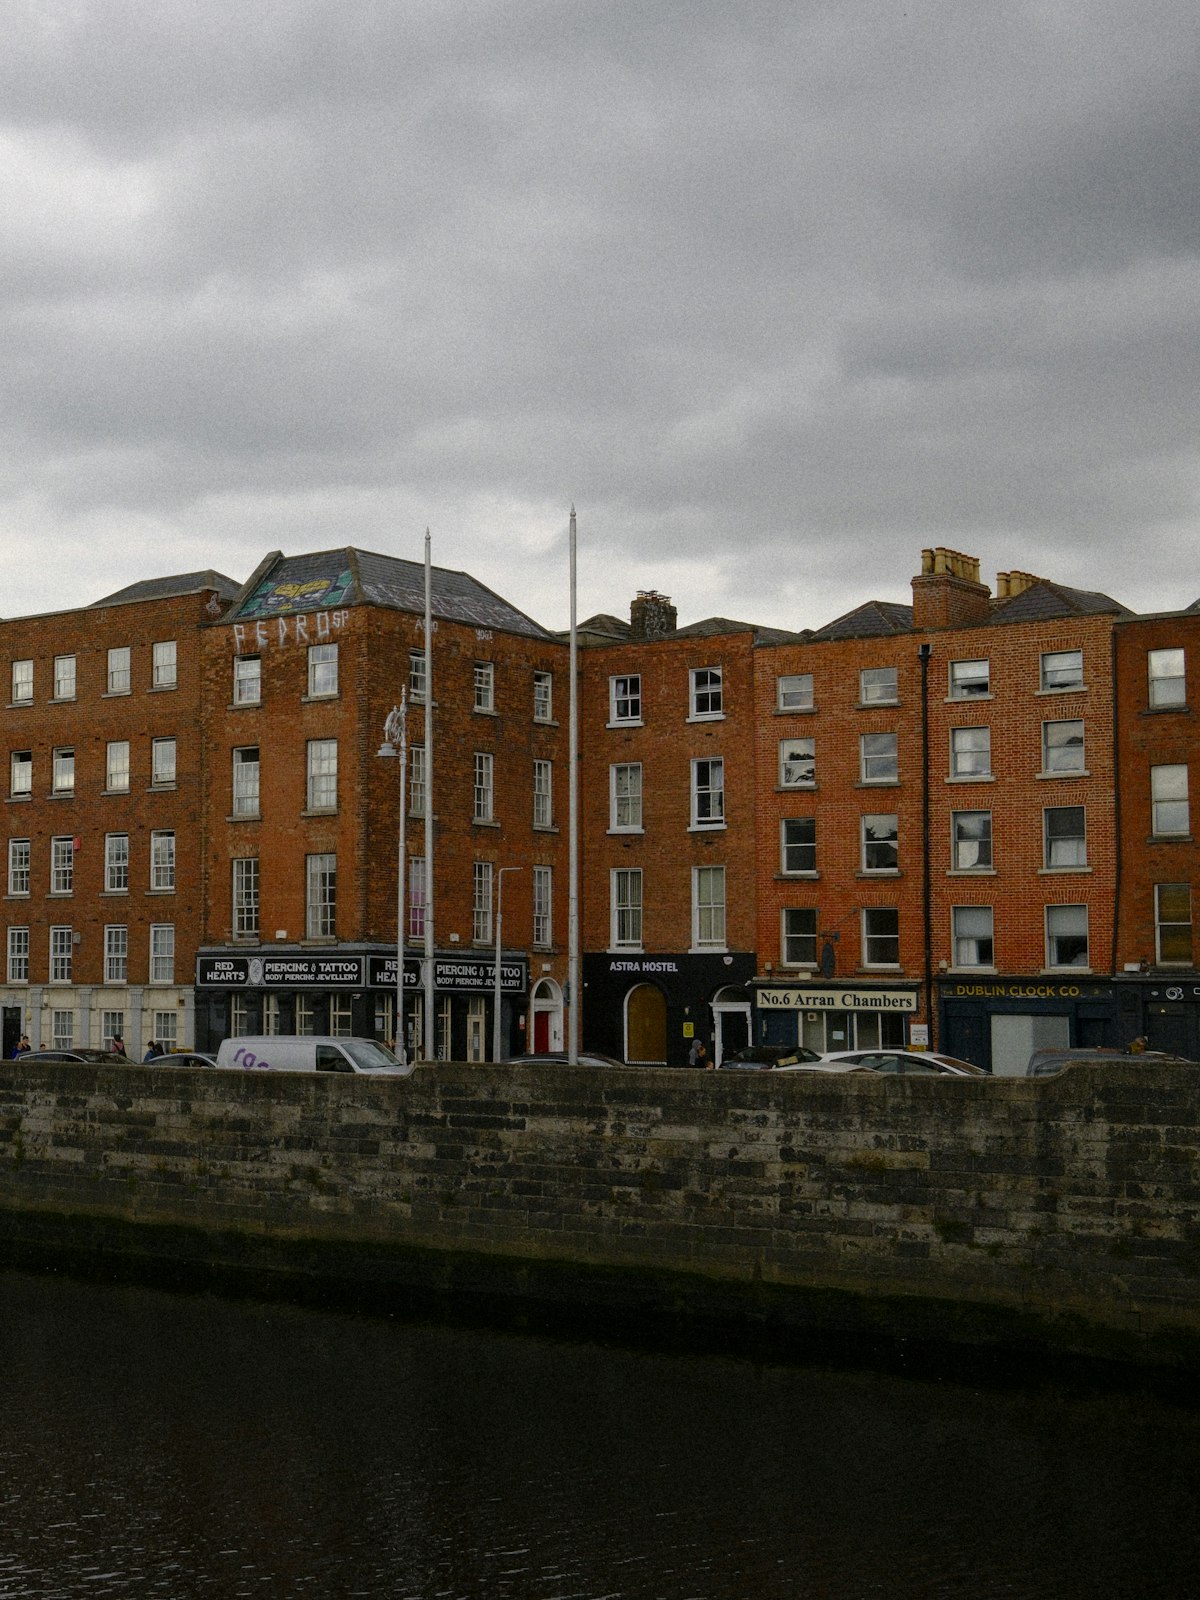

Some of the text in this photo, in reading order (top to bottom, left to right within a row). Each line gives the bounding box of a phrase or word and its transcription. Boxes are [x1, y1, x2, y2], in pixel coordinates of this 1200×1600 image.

[233, 611, 330, 653] PEDRO
[214, 962, 234, 971] RED
[265, 963, 309, 972] PIERCING
[319, 963, 358, 972] TATTOO
[436, 965, 478, 977] PIERCING
[487, 967, 521, 978] TATOO
[609, 961, 679, 972] ASTRA HOSTEL
[206, 972, 245, 981] HEARTS
[376, 972, 417, 984] HEATS
[436, 976, 521, 988] BODY PIERCING JEWLLERY
[956, 985, 1006, 996] DUBLIN
[1008, 986, 1056, 997] CLOCK
[759, 992, 912, 1008] No.6 Arran Chambers
